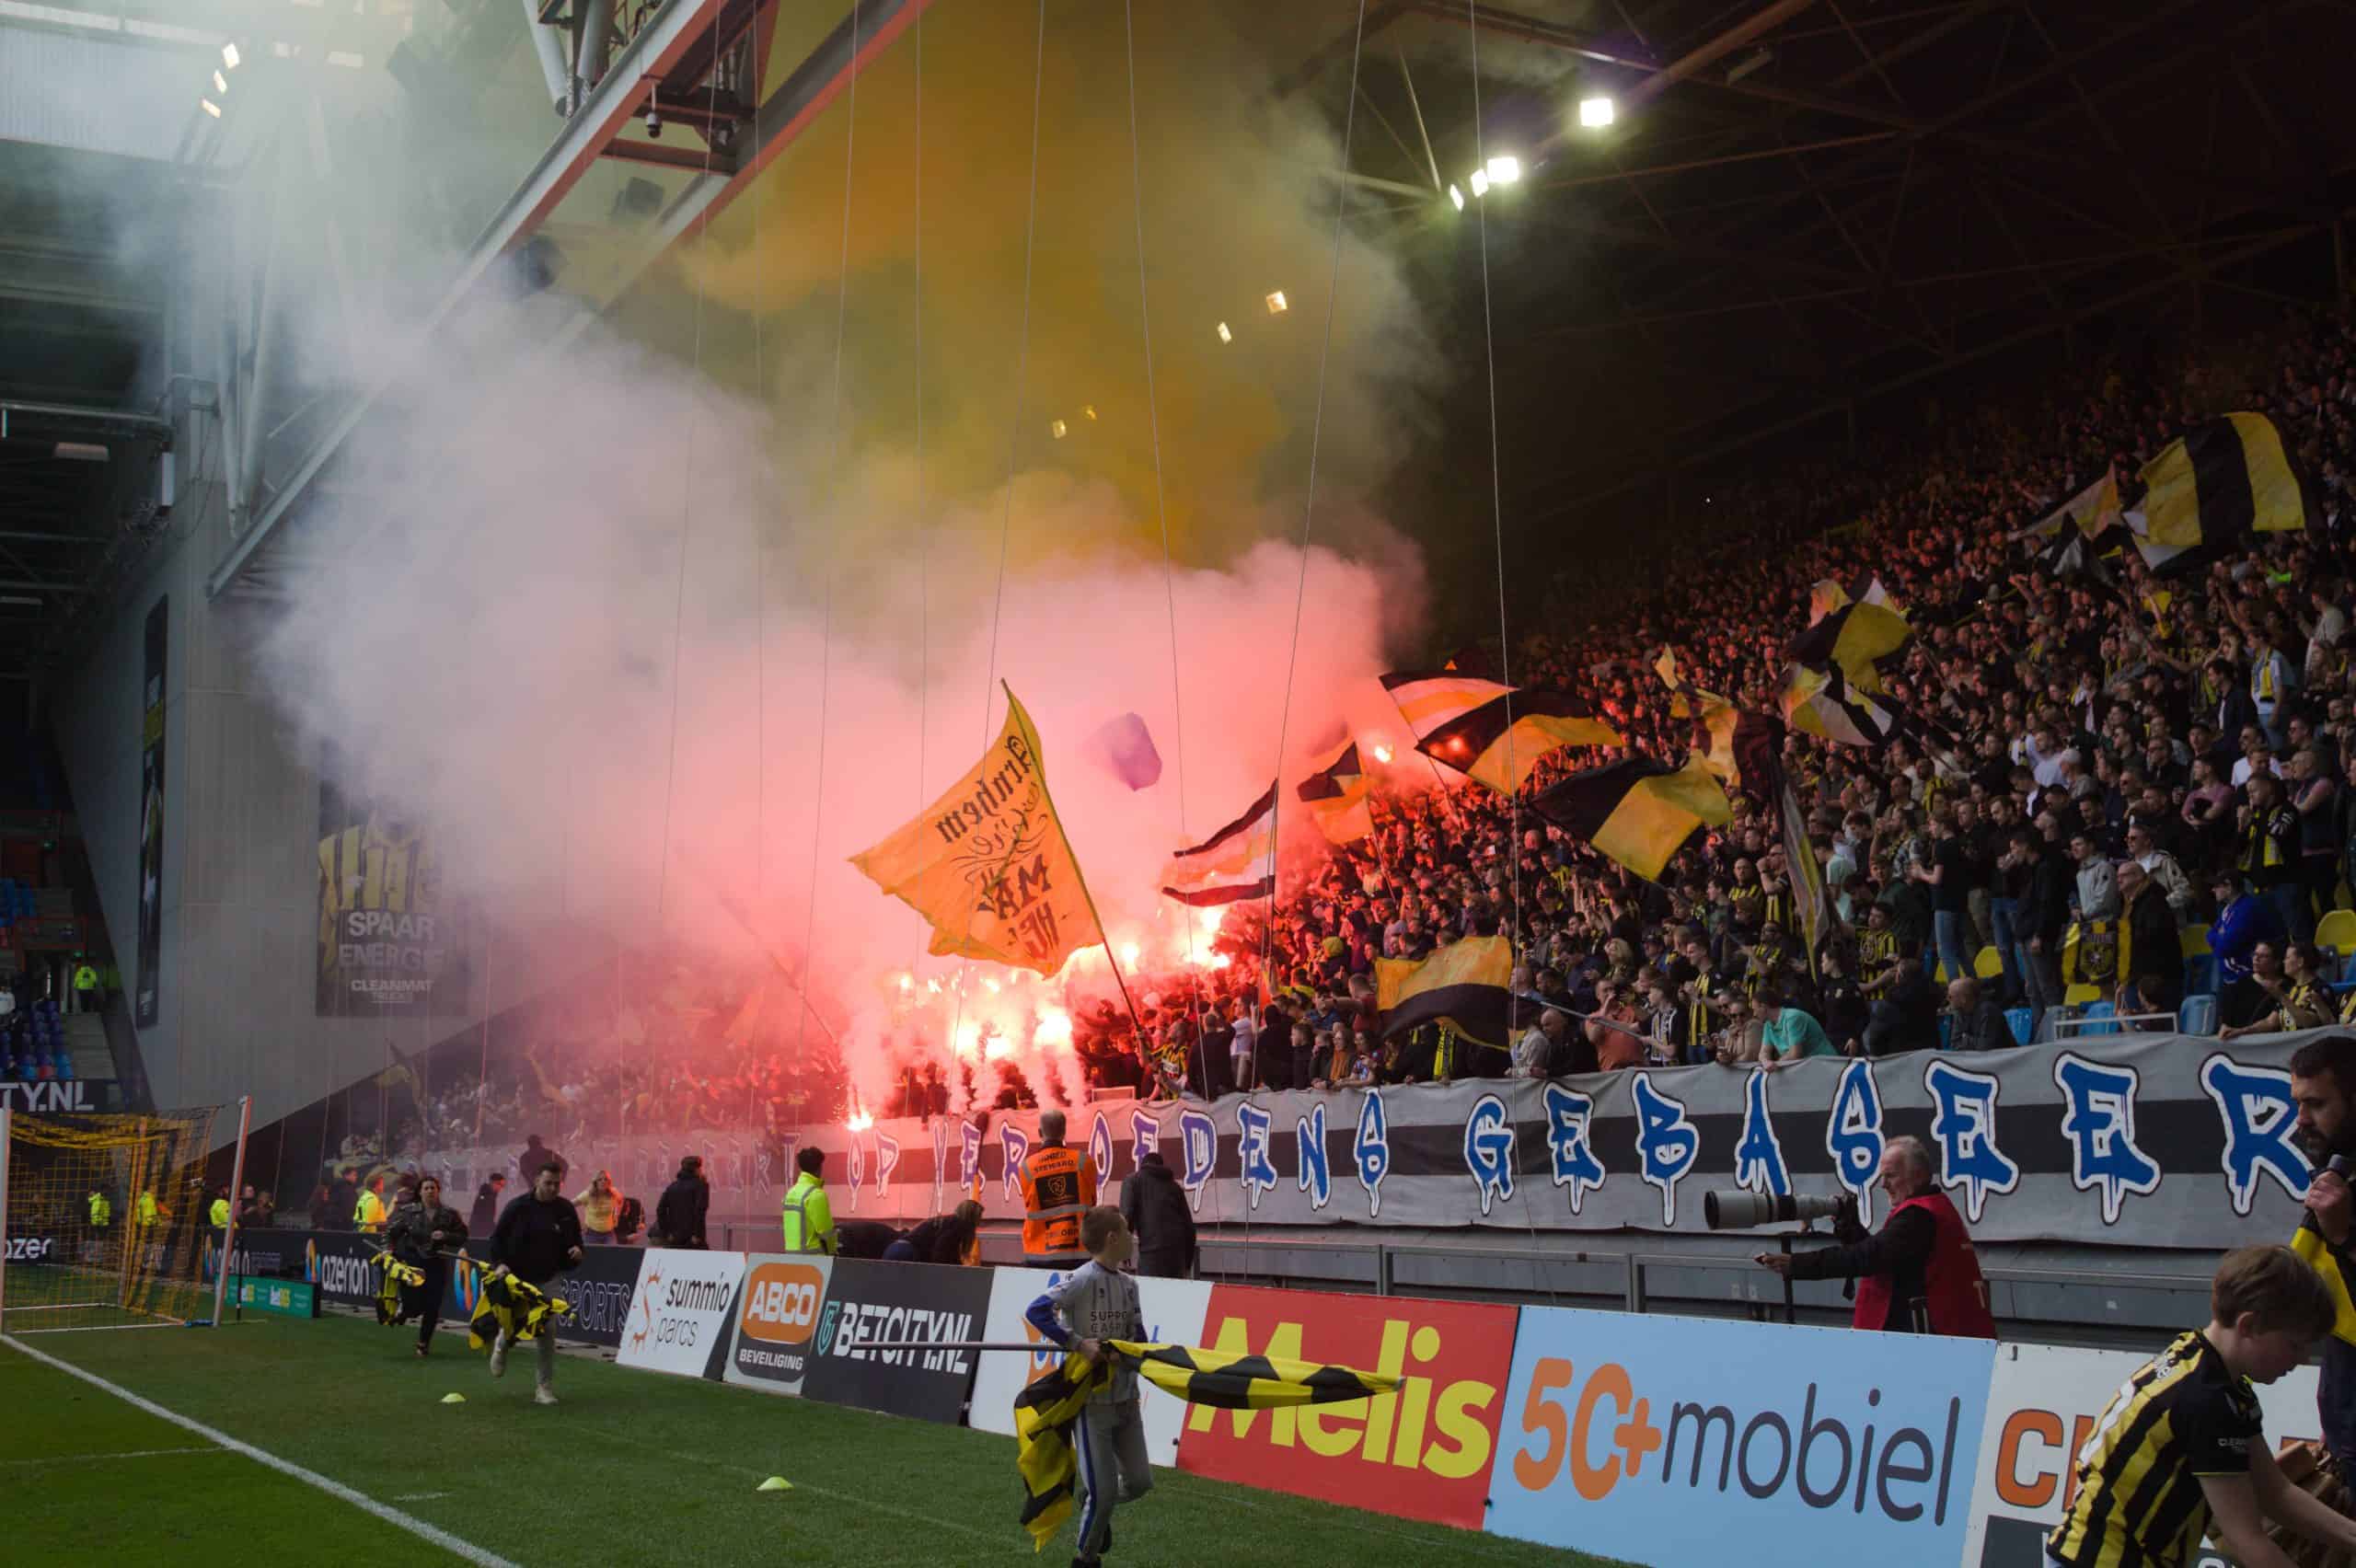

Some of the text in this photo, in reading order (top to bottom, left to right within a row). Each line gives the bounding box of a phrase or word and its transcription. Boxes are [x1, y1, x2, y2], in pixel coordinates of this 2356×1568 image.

[349, 911, 434, 941] SPAAR
[339, 943, 445, 972] ENERGIE
[933, 1089, 1390, 1217] VEROEDENS
[322, 1247, 370, 1296] azerion
[666, 1272, 730, 1312] summio
[746, 1280, 816, 1326] ABCO
[653, 1316, 699, 1350] parcs
[739, 1348, 803, 1370] BEVEILIGING
